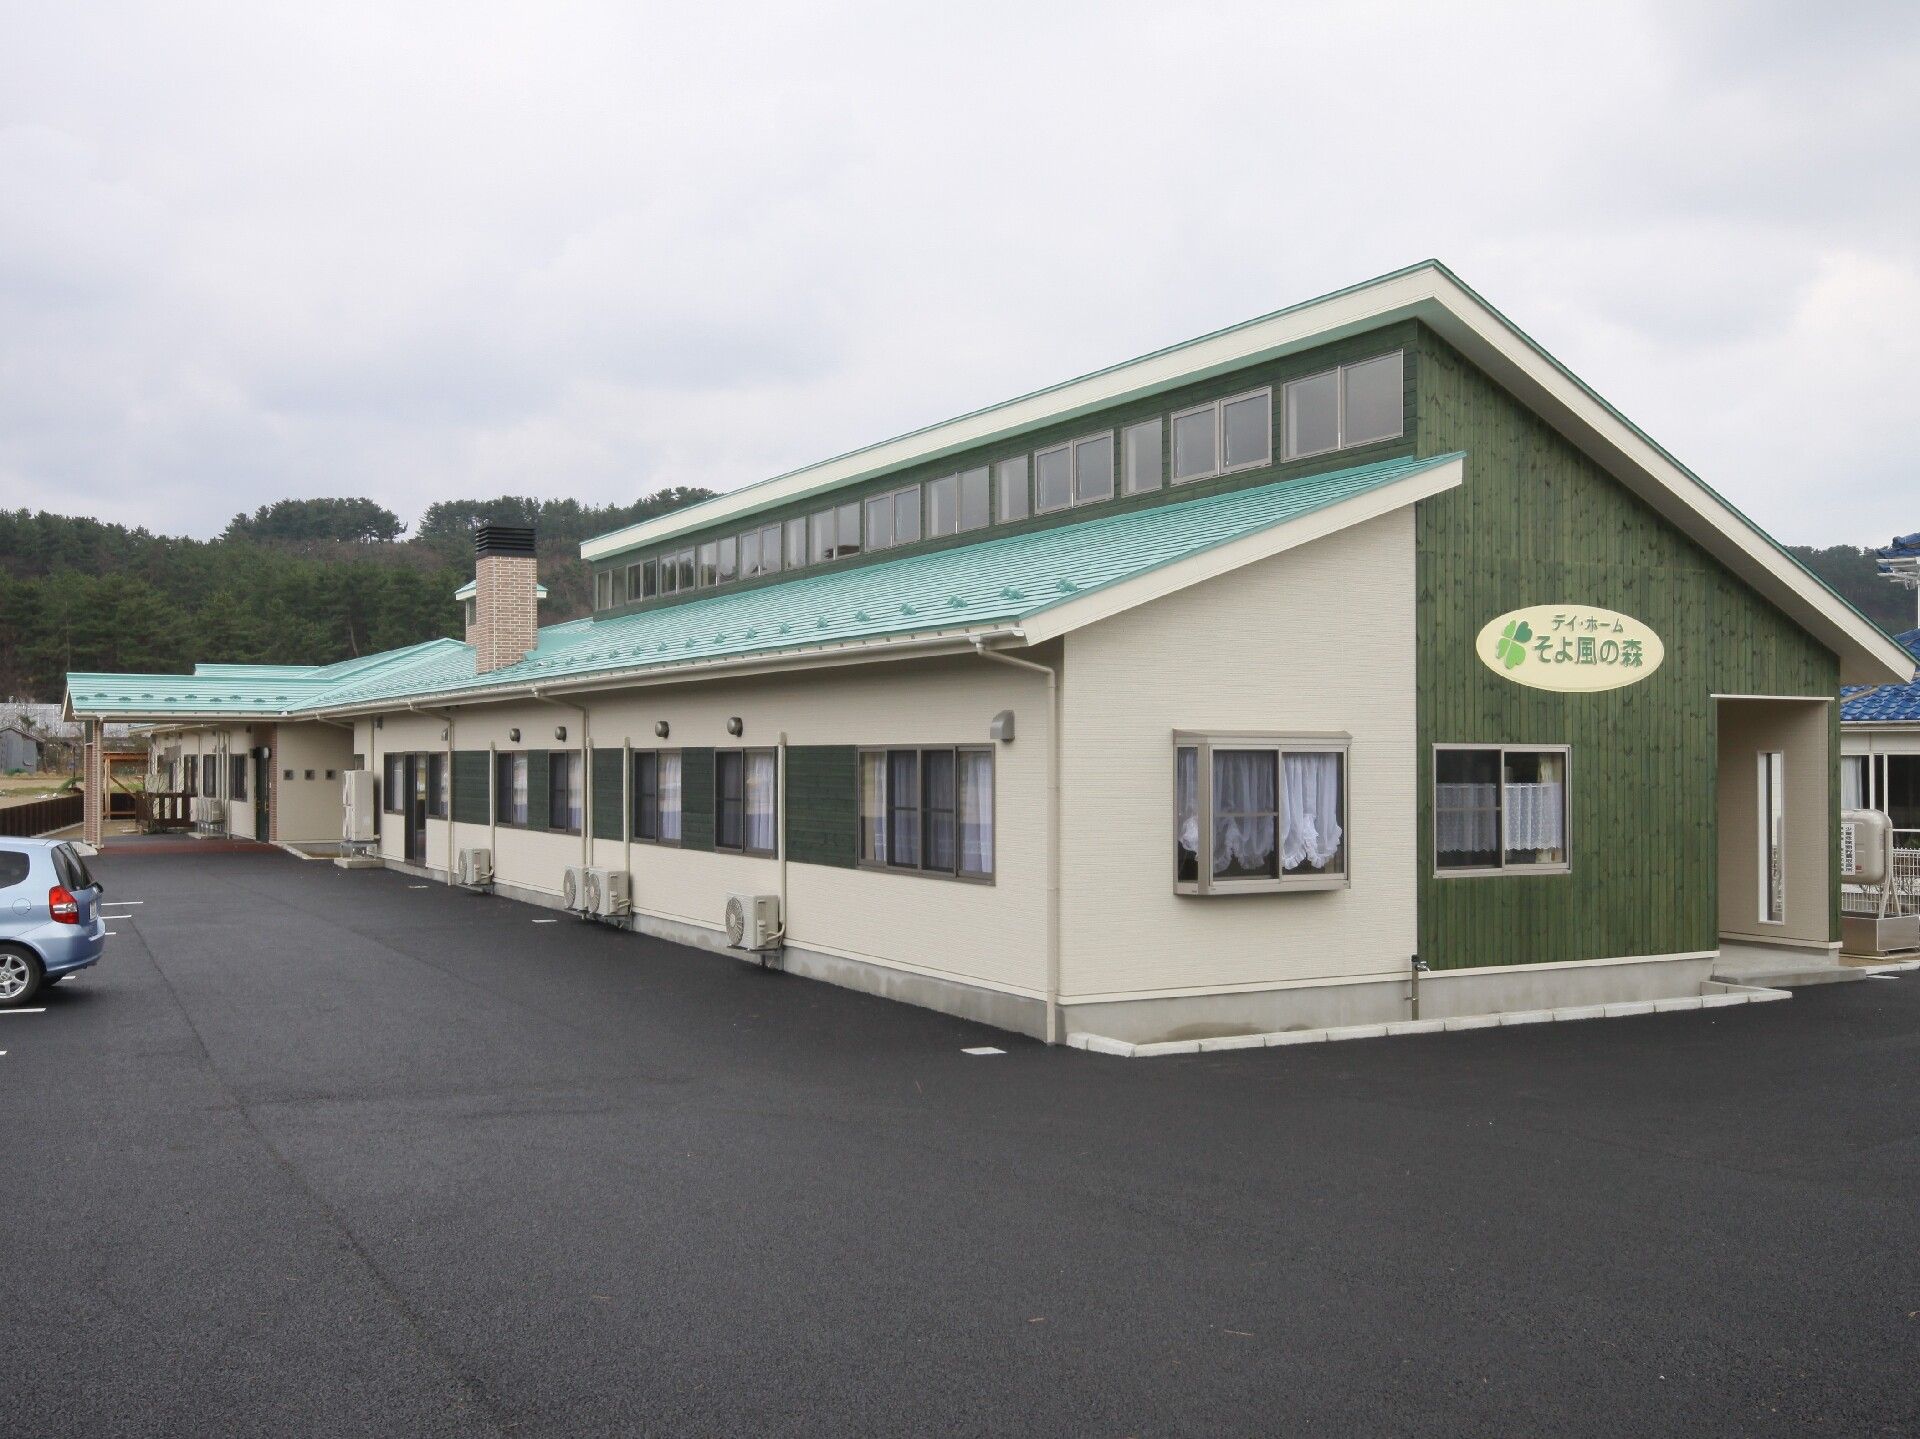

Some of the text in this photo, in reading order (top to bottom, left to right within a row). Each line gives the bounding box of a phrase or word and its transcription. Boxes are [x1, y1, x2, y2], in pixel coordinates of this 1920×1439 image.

[1534, 635, 1643, 667] そよ風の森
